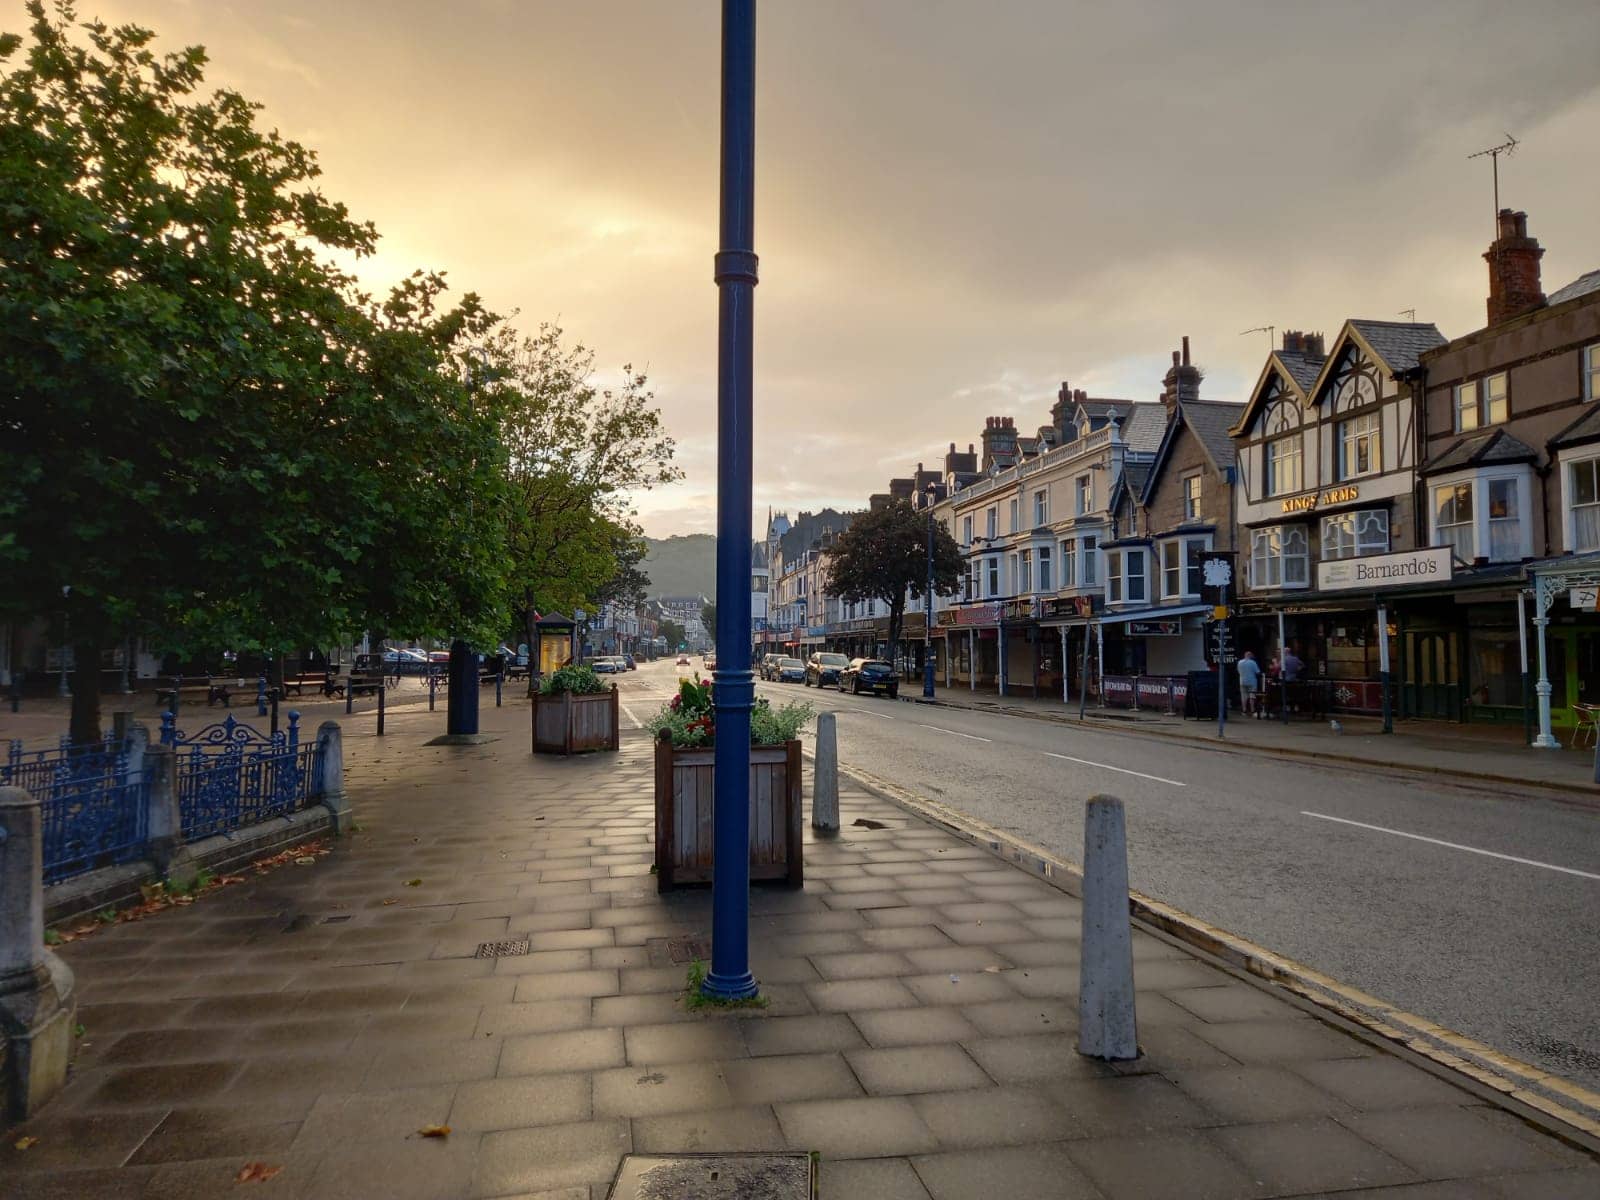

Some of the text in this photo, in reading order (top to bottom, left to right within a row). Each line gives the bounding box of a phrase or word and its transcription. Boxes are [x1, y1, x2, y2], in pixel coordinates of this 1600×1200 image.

[1282, 486, 1358, 512] KINGS ARMS
[1357, 558, 1437, 580] Barnardo's
